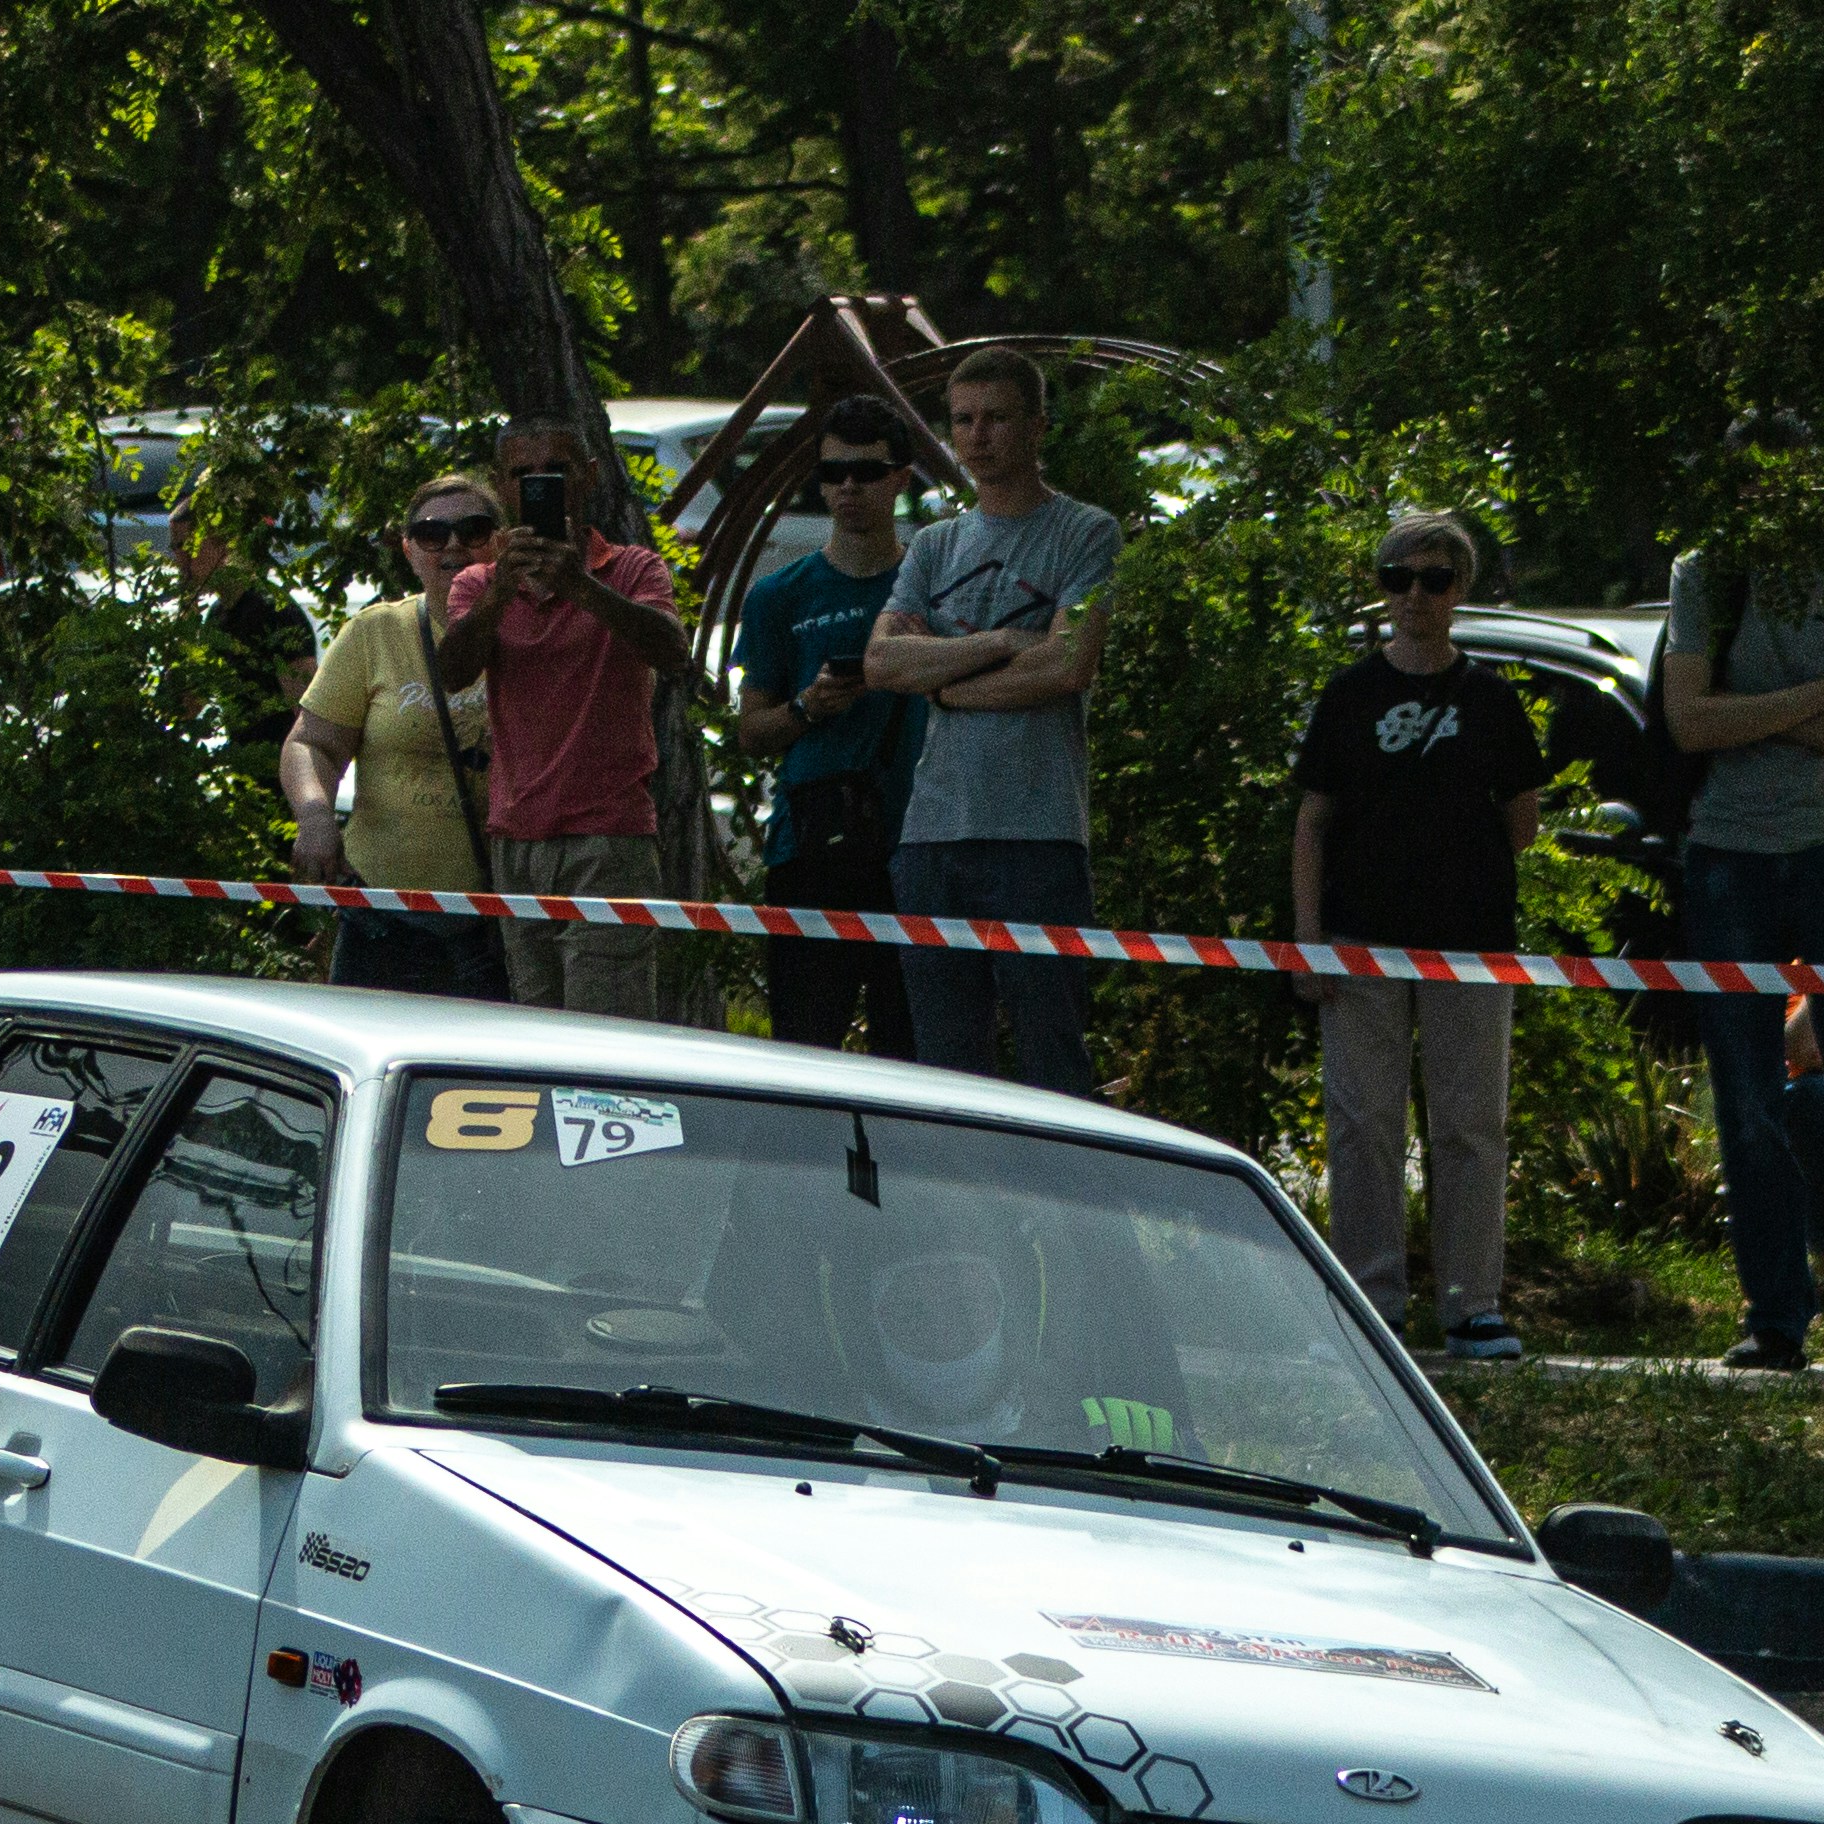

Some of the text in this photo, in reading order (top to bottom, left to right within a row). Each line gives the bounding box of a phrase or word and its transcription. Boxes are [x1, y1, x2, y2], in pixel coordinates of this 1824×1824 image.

[426, 1089, 540, 1149] 6
[563, 1116, 635, 1161] 79
[311, 1548, 371, 1582] SS20
